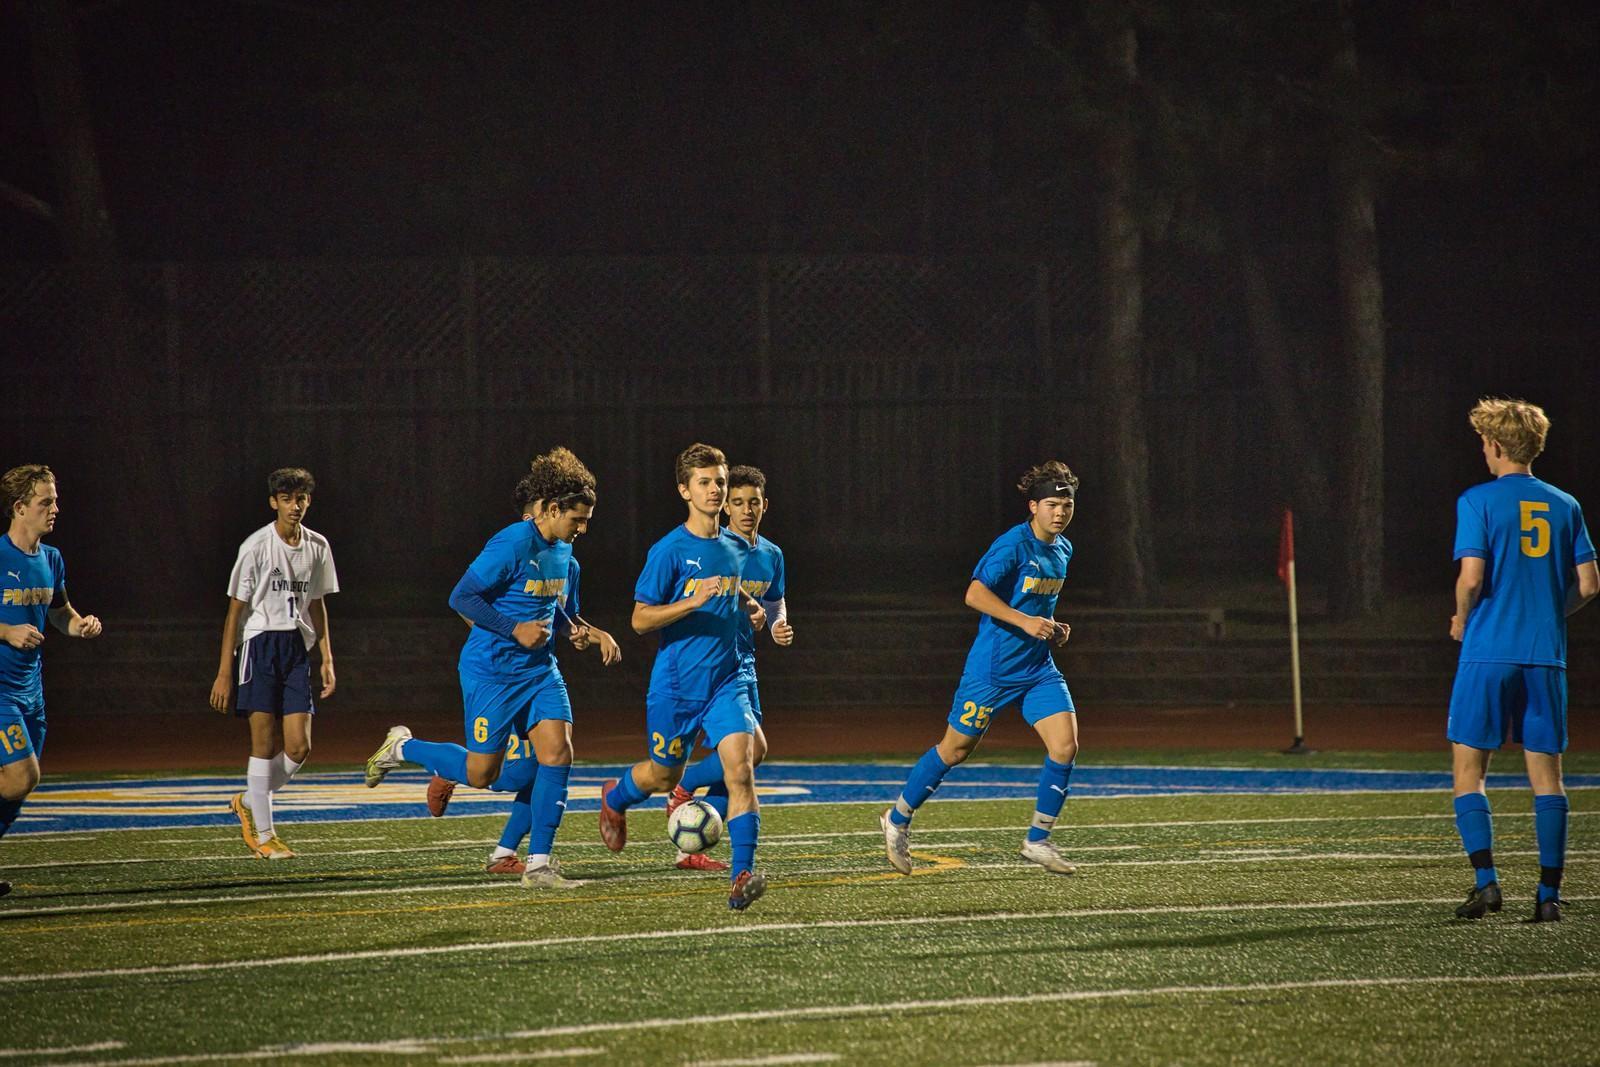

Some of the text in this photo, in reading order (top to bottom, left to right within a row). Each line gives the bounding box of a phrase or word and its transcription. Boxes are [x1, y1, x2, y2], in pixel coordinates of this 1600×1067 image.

[1520, 500, 1550, 558] 5
[960, 701, 993, 728] 25
[0, 725, 26, 754] 13
[474, 717, 488, 743] 6
[507, 734, 531, 760] 21
[652, 731, 682, 759] 24
